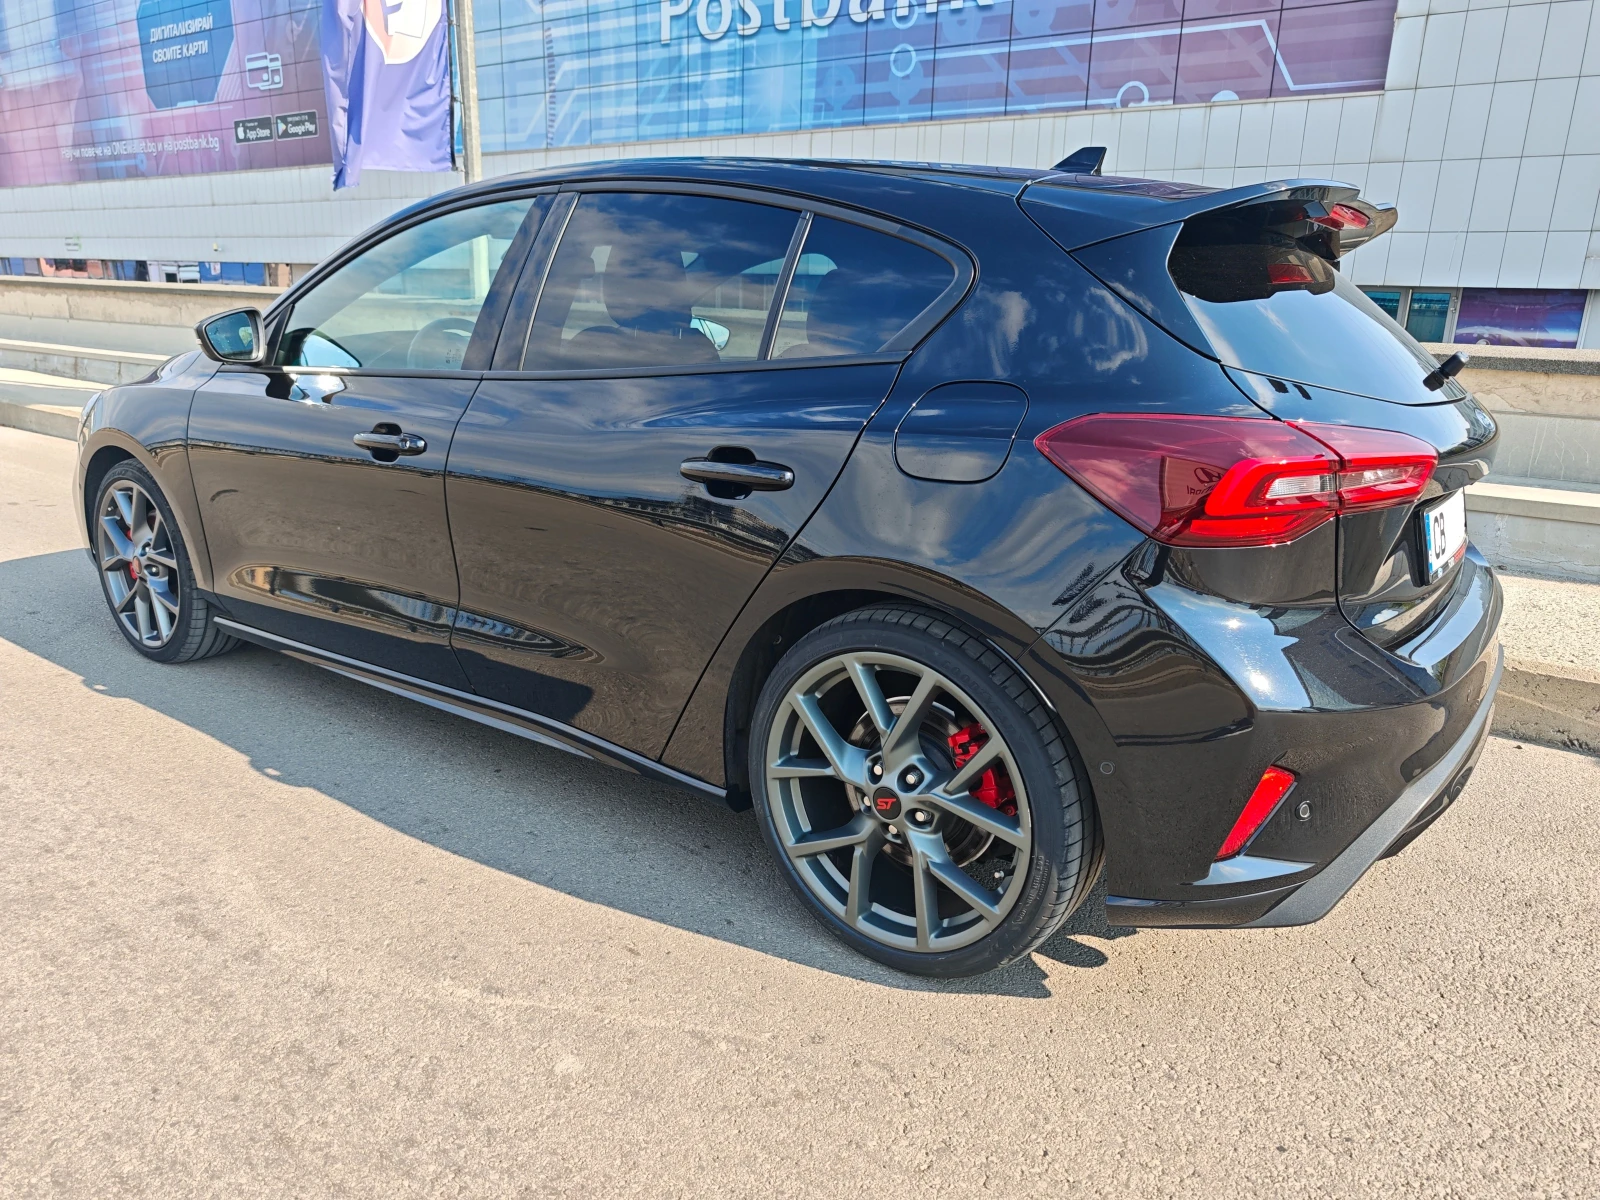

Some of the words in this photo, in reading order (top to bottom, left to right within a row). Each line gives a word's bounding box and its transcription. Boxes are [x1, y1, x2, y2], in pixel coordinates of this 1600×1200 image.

[150, 12, 214, 44] ДИГИТАЛИЗИРАЙ
[152, 45, 182, 63] СВОИТЕ
[182, 40, 209, 58] КАРТИ
[246, 129, 257, 140] App
[256, 127, 271, 138] Store
[287, 123, 306, 135] Google
[304, 121, 316, 133] Play
[61, 148, 80, 161] Научи
[81, 147, 103, 158] повече
[103, 147, 112, 156] на
[157, 142, 163, 151] и
[163, 141, 173, 151] на
[174, 133, 220, 154] postbank.bg
[1433, 512, 1446, 560] CB
[876, 798, 897, 810] ST
